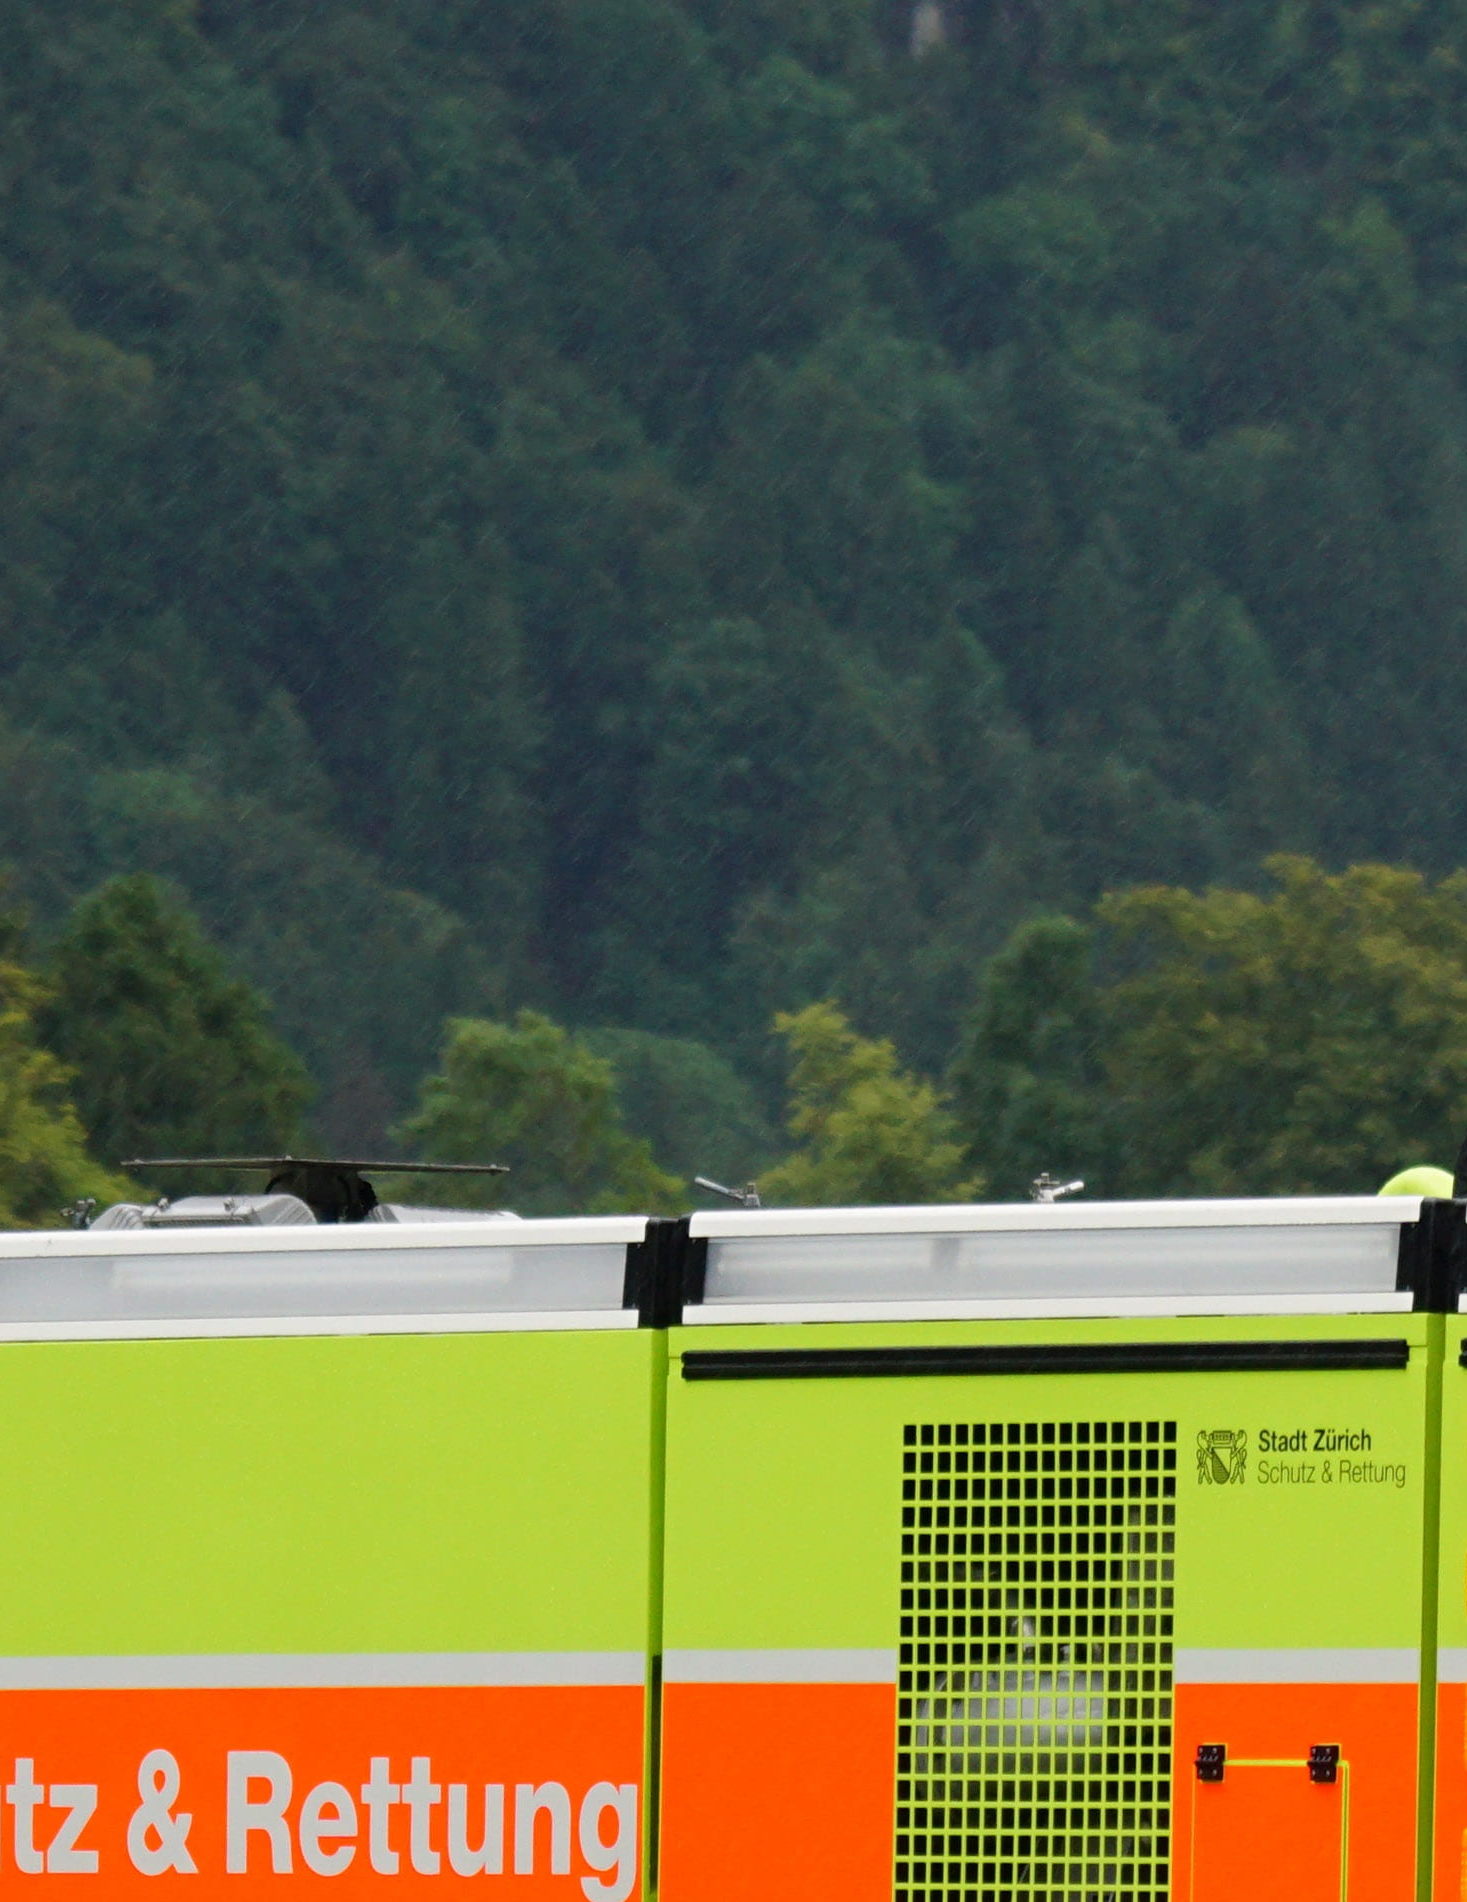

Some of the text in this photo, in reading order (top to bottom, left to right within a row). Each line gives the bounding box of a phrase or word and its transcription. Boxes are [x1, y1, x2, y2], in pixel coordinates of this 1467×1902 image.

[1258, 1428, 1372, 1452] Stadt Zürich
[1257, 1459, 1406, 1489] Schutz & Rettung
[126, 1748, 199, 1876] &
